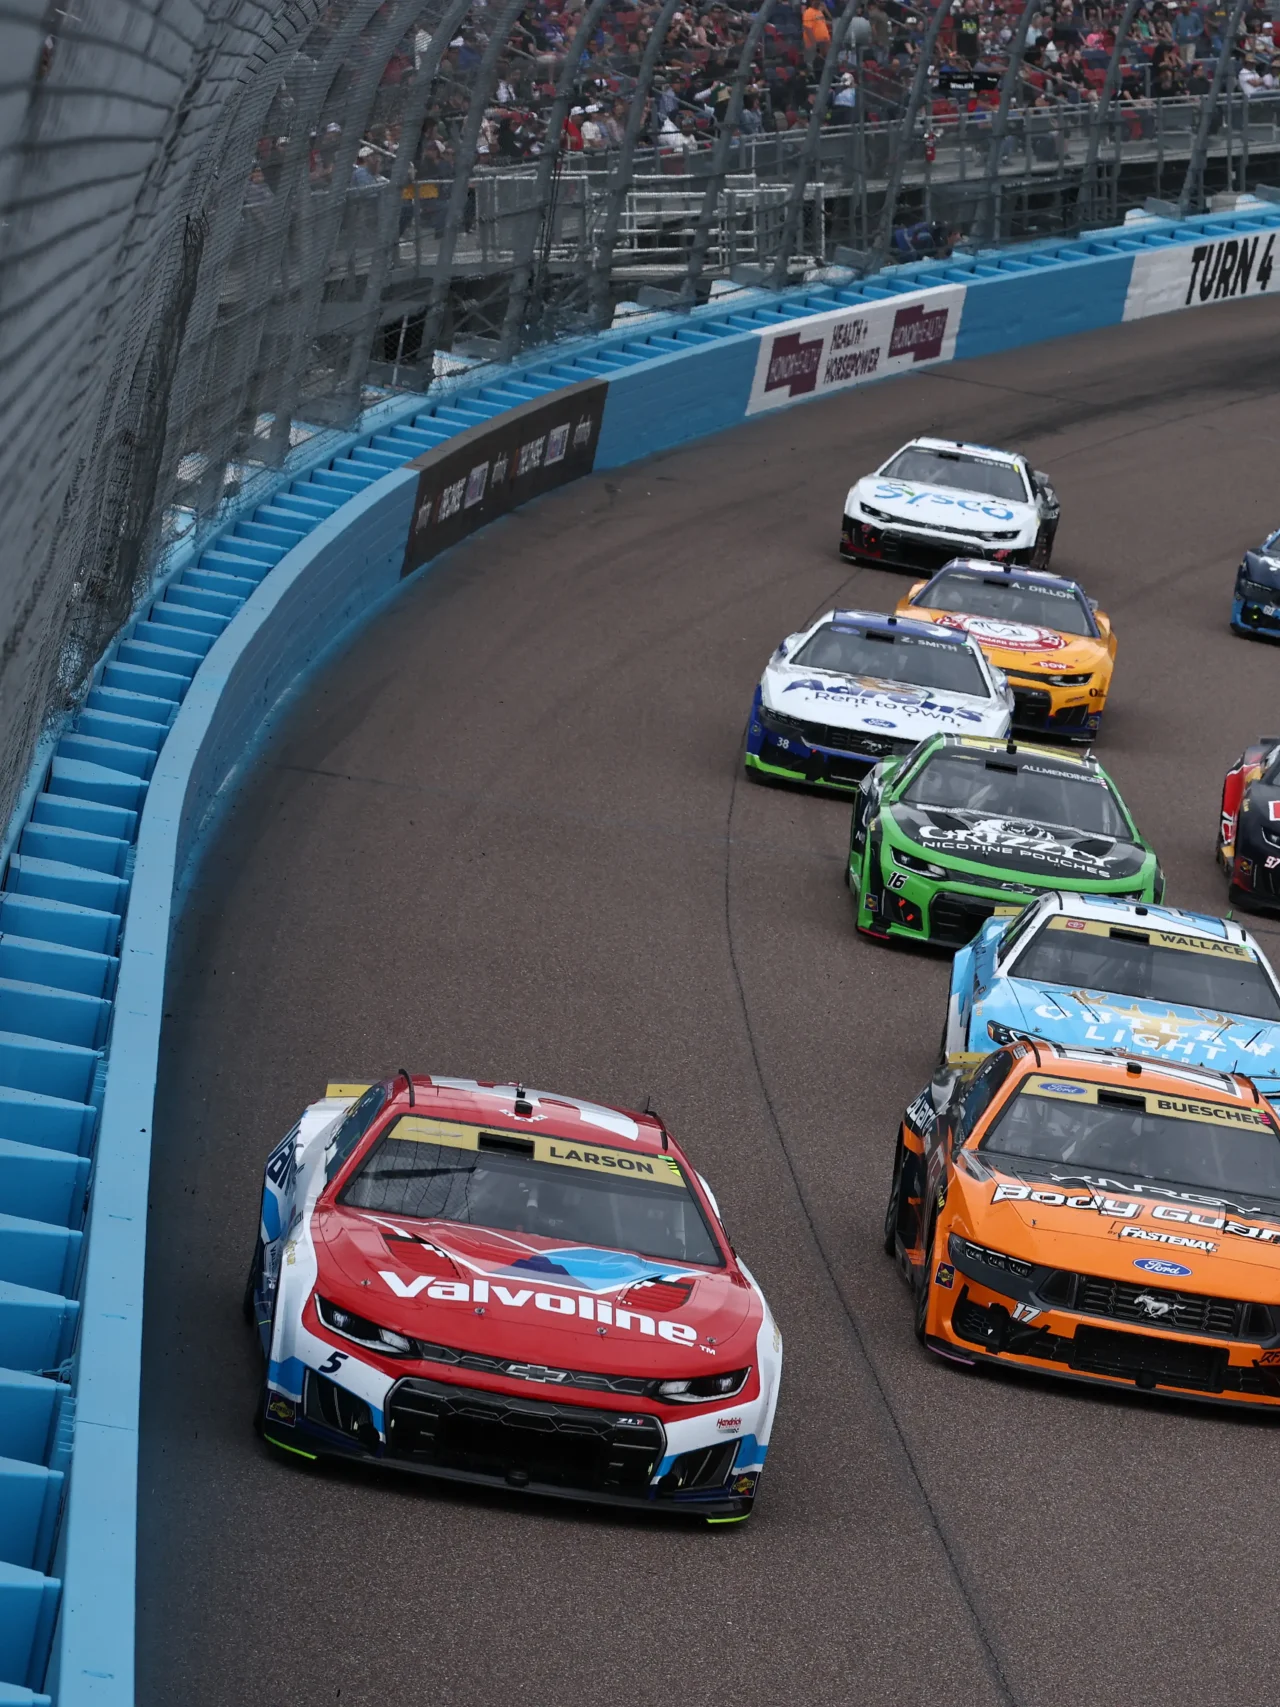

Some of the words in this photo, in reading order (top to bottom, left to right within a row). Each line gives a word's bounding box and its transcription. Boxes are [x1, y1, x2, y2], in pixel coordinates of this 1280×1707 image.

[1185, 236, 1259, 306] TURN
[1256, 233, 1275, 291] 4
[830, 319, 864, 354] HEALTH
[824, 347, 880, 384] HORSEPOWER
[1028, 585, 1075, 600] DILLON
[918, 640, 957, 652] SMITH
[815, 692, 868, 706] Rent
[875, 700, 897, 710] to
[902, 705, 955, 724] Own
[777, 737, 789, 749] 38
[919, 825, 1117, 868] GRIZZLY
[923, 841, 1013, 855] NICOTINE
[1020, 850, 1110, 878] POUCHES
[887, 871, 909, 890] 16
[1160, 934, 1245, 957] WALLACE
[1085, 1025, 1227, 1060] LIGHT
[1045, 1082, 1079, 1095] Ford
[550, 1146, 654, 1175] LARSON
[990, 1184, 1144, 1218] Body
[1143, 1259, 1182, 1275] Ford
[378, 1271, 698, 1347] Valvoline
[1012, 1301, 1041, 1323] 17
[318, 1351, 349, 1374] 5
